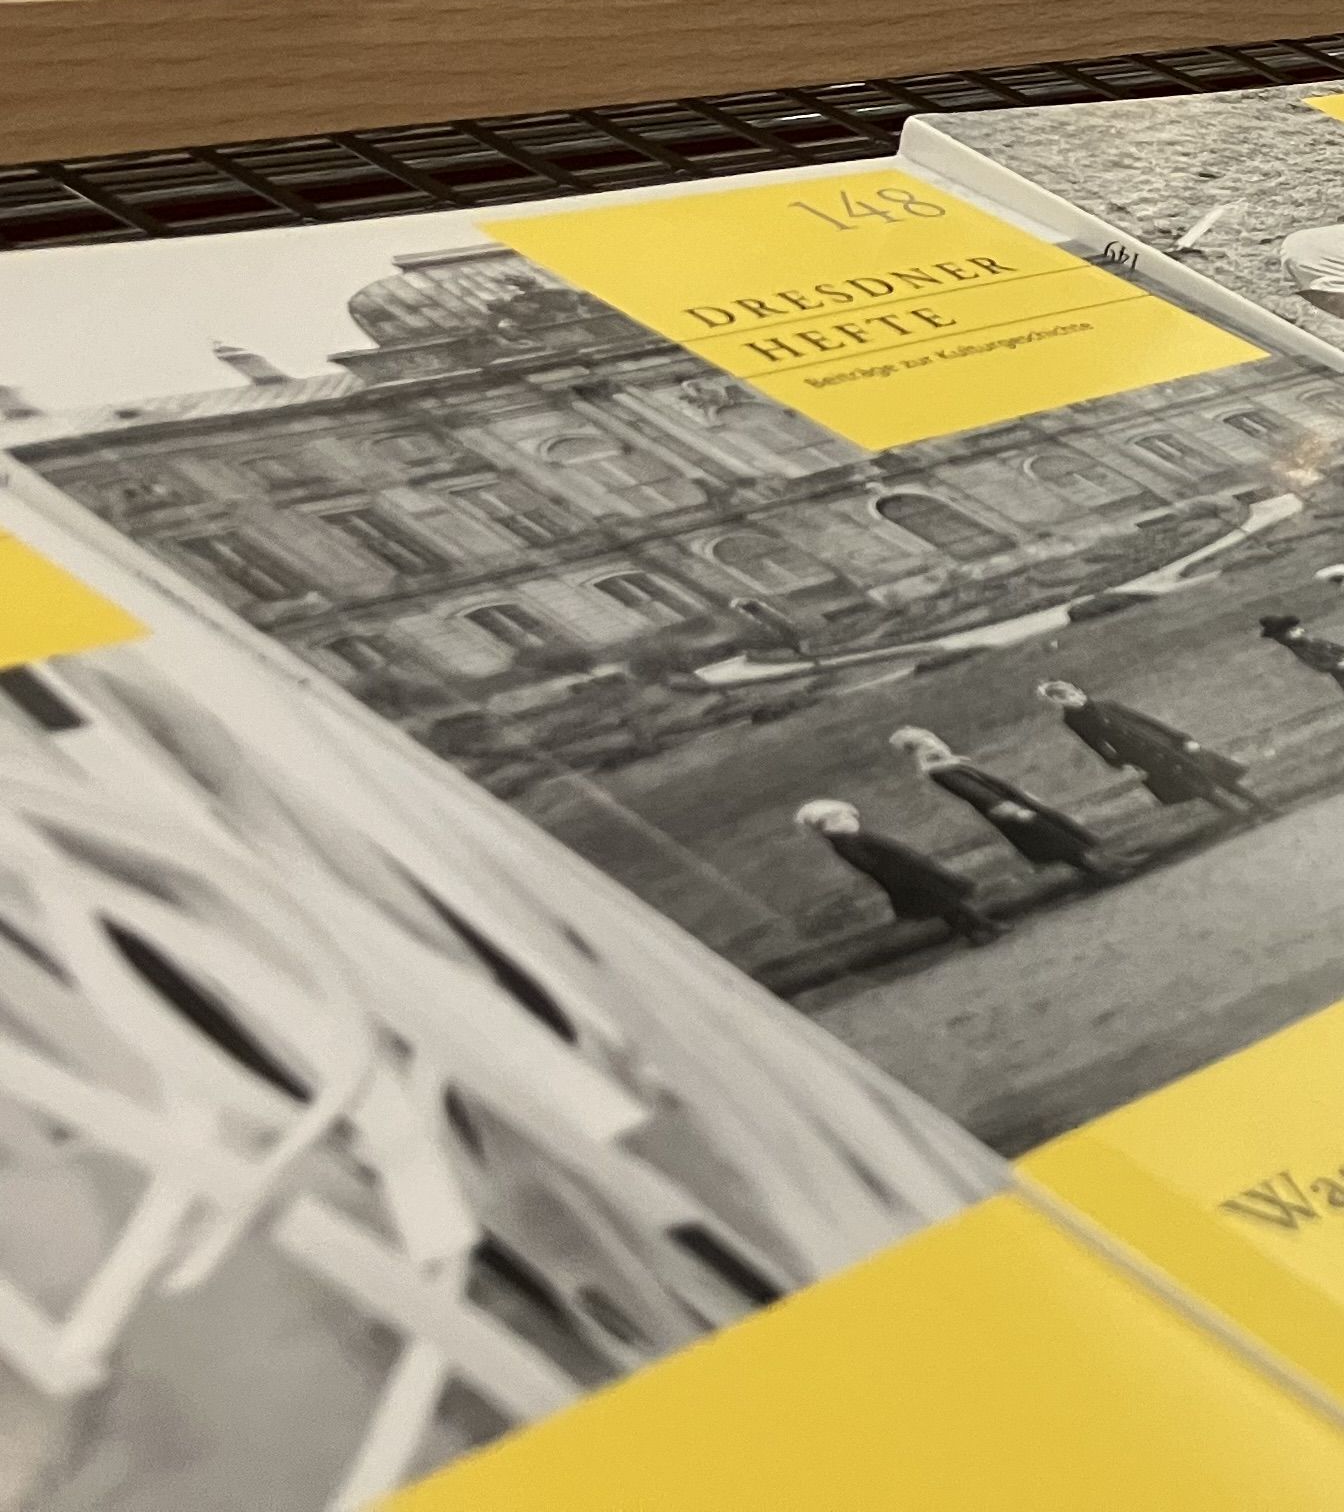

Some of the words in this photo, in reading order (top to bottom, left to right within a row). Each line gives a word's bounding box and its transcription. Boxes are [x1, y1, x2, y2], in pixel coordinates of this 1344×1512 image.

[789, 186, 947, 231] 148
[683, 255, 1018, 329] DRESDNER
[743, 305, 959, 363] HEFTE
